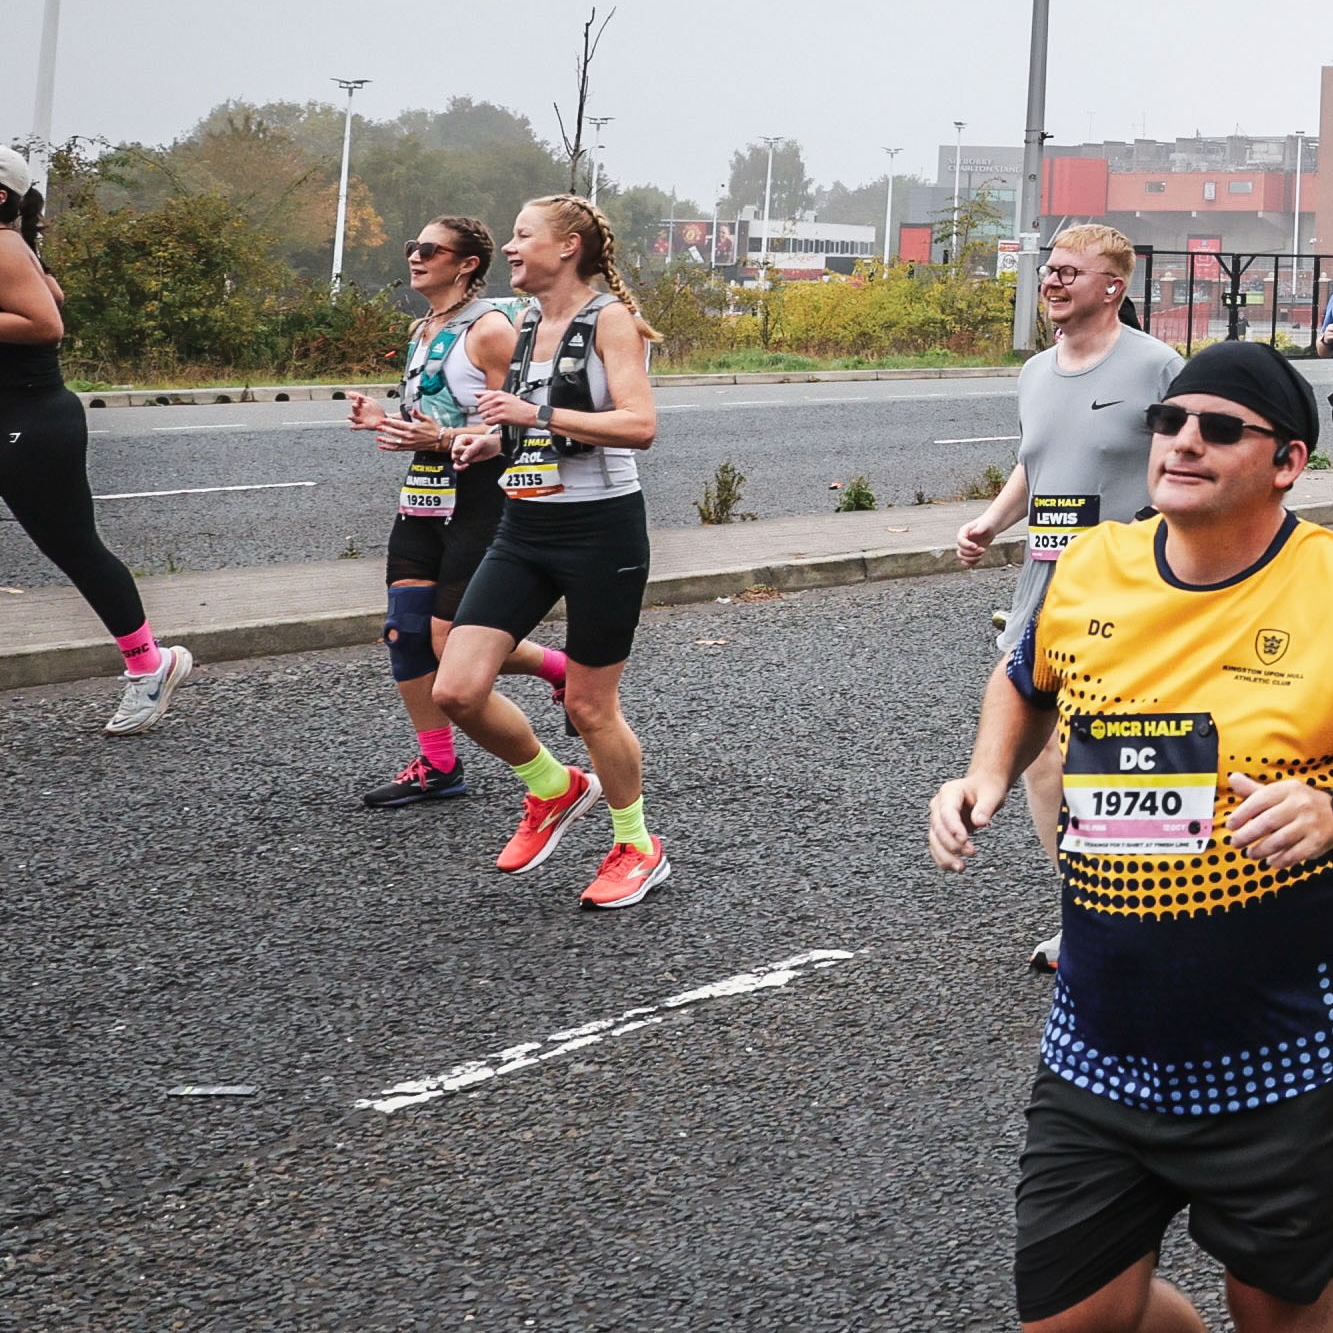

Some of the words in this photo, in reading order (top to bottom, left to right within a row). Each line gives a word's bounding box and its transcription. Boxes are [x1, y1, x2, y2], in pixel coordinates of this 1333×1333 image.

[506, 473, 543, 487] 23135
[407, 494, 442, 507] 19269
[1040, 498, 1057, 507] MCR
[1057, 498, 1086, 507] HALF
[1036, 512, 1078, 525] LEWIS
[1034, 535, 1078, 549] 2034
[1087, 618, 1115, 639] DC
[1222, 665, 1262, 675] KINGSTON
[1263, 670, 1285, 678] UPON
[1233, 674, 1270, 685] ATHLETIC
[1106, 721, 1143, 737] MCR
[1143, 719, 1194, 737] HALF
[1119, 746, 1157, 771] DC
[1092, 790, 1183, 817] 19740
